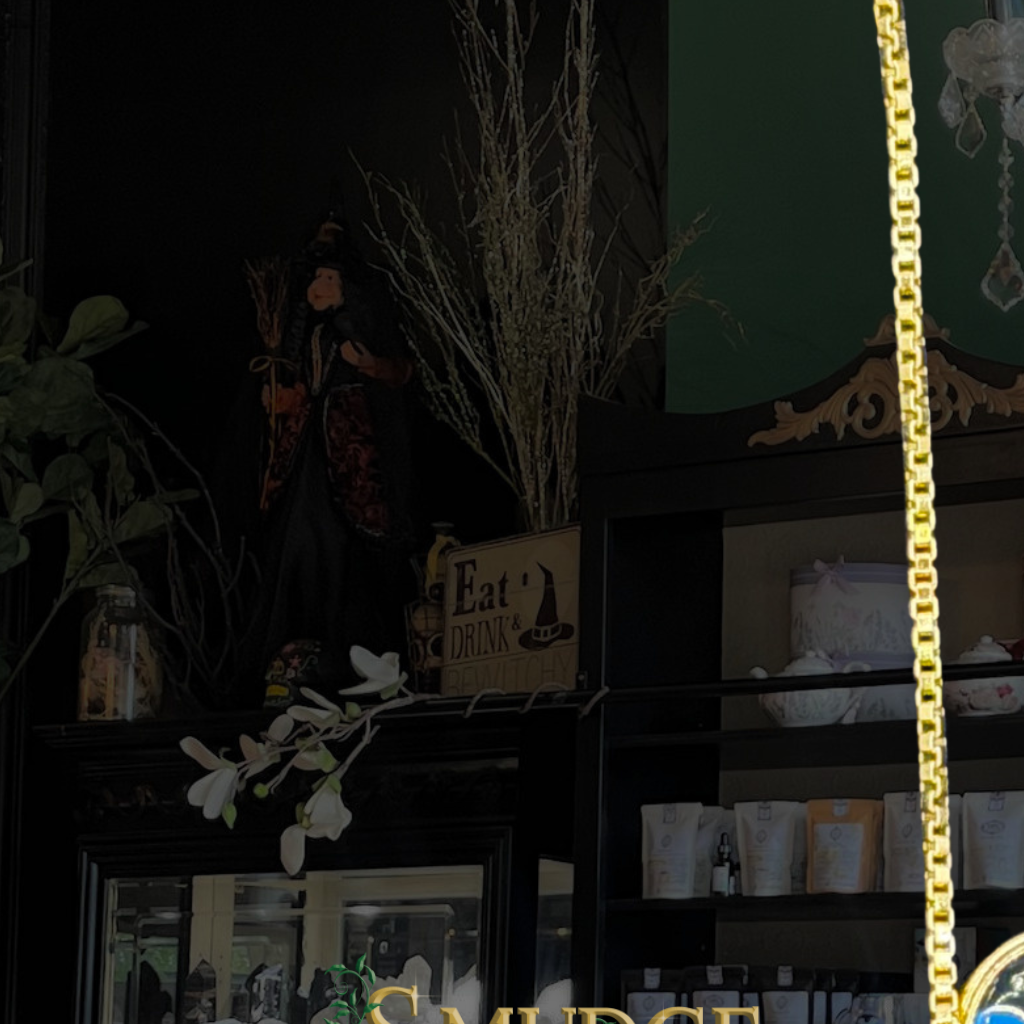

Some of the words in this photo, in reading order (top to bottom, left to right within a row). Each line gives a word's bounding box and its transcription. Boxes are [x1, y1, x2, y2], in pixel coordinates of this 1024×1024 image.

[452, 559, 509, 616] Eat
[451, 616, 510, 660] DRINK
[511, 613, 522, 630] &
